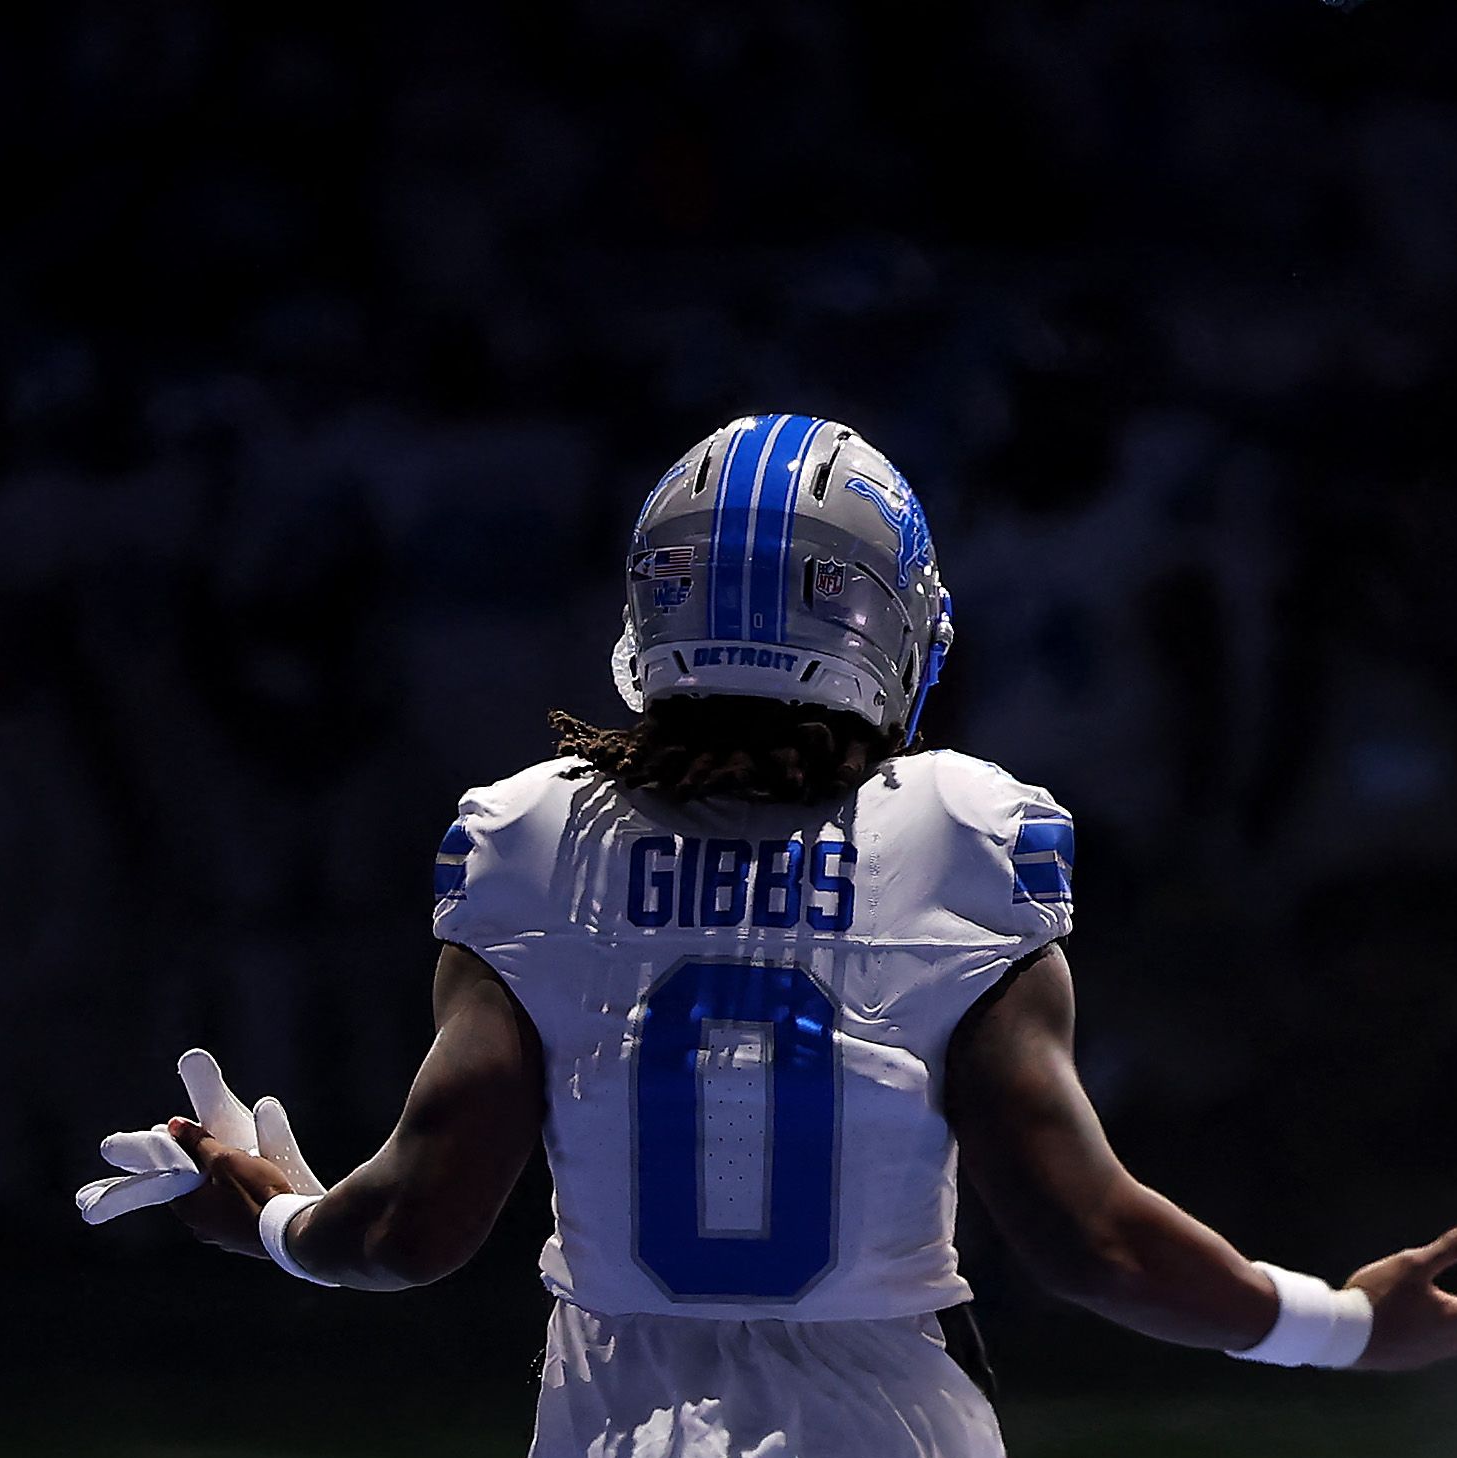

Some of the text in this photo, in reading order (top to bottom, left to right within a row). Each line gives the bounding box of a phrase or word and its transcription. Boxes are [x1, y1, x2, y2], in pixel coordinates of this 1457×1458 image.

[817, 573, 842, 593] NFL
[753, 612, 763, 628] 0
[693, 647, 799, 672] DETROIT
[627, 836, 858, 930] GIBBS
[630, 955, 844, 1304] 0
